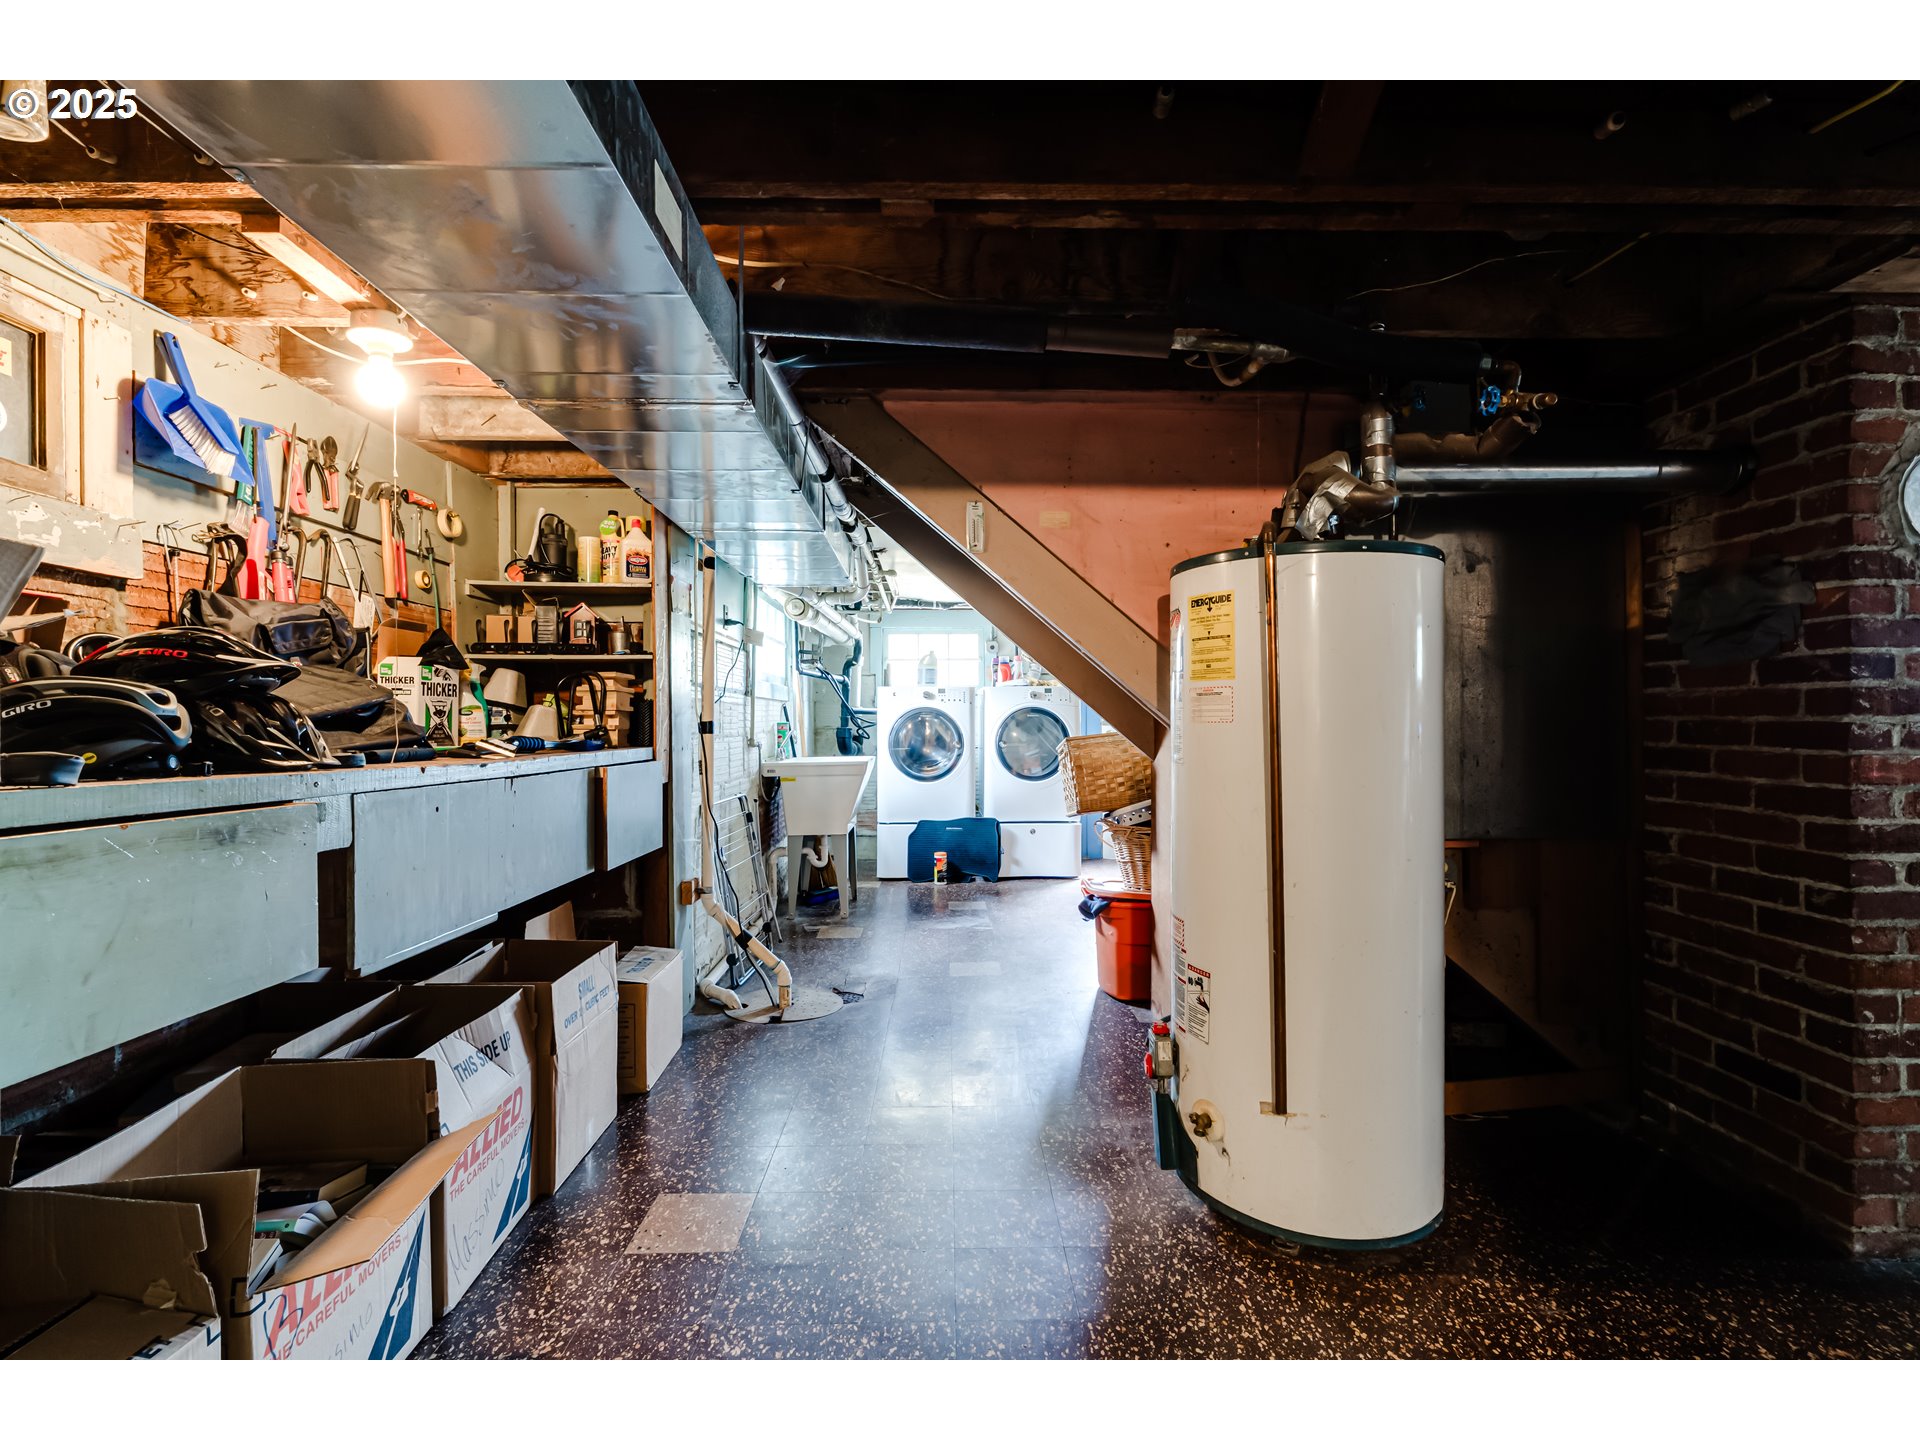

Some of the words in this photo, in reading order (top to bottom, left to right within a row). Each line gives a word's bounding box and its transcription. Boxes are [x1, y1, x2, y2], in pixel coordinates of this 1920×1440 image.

[138, 648, 189, 658] GIRO
[380, 676, 415, 685] THICKER
[421, 682, 458, 697] THICKER
[1, 700, 52, 719] GIRO
[577, 975, 596, 1000] SMALL
[563, 1011, 578, 1029] OVER
[585, 994, 600, 1011] CUBIC
[599, 985, 610, 999] FEET
[453, 1056, 479, 1083] THIS
[475, 1040, 500, 1067] SIDE
[500, 1031, 511, 1052] UP
[449, 1179, 466, 1202] THE
[466, 1148, 500, 1185] CAREFUL
[500, 1118, 525, 1151] MOVERS
[273, 1341, 293, 1360] HE
[295, 1283, 356, 1346] CAREFUL
[359, 1234, 402, 1286] MOVERS
